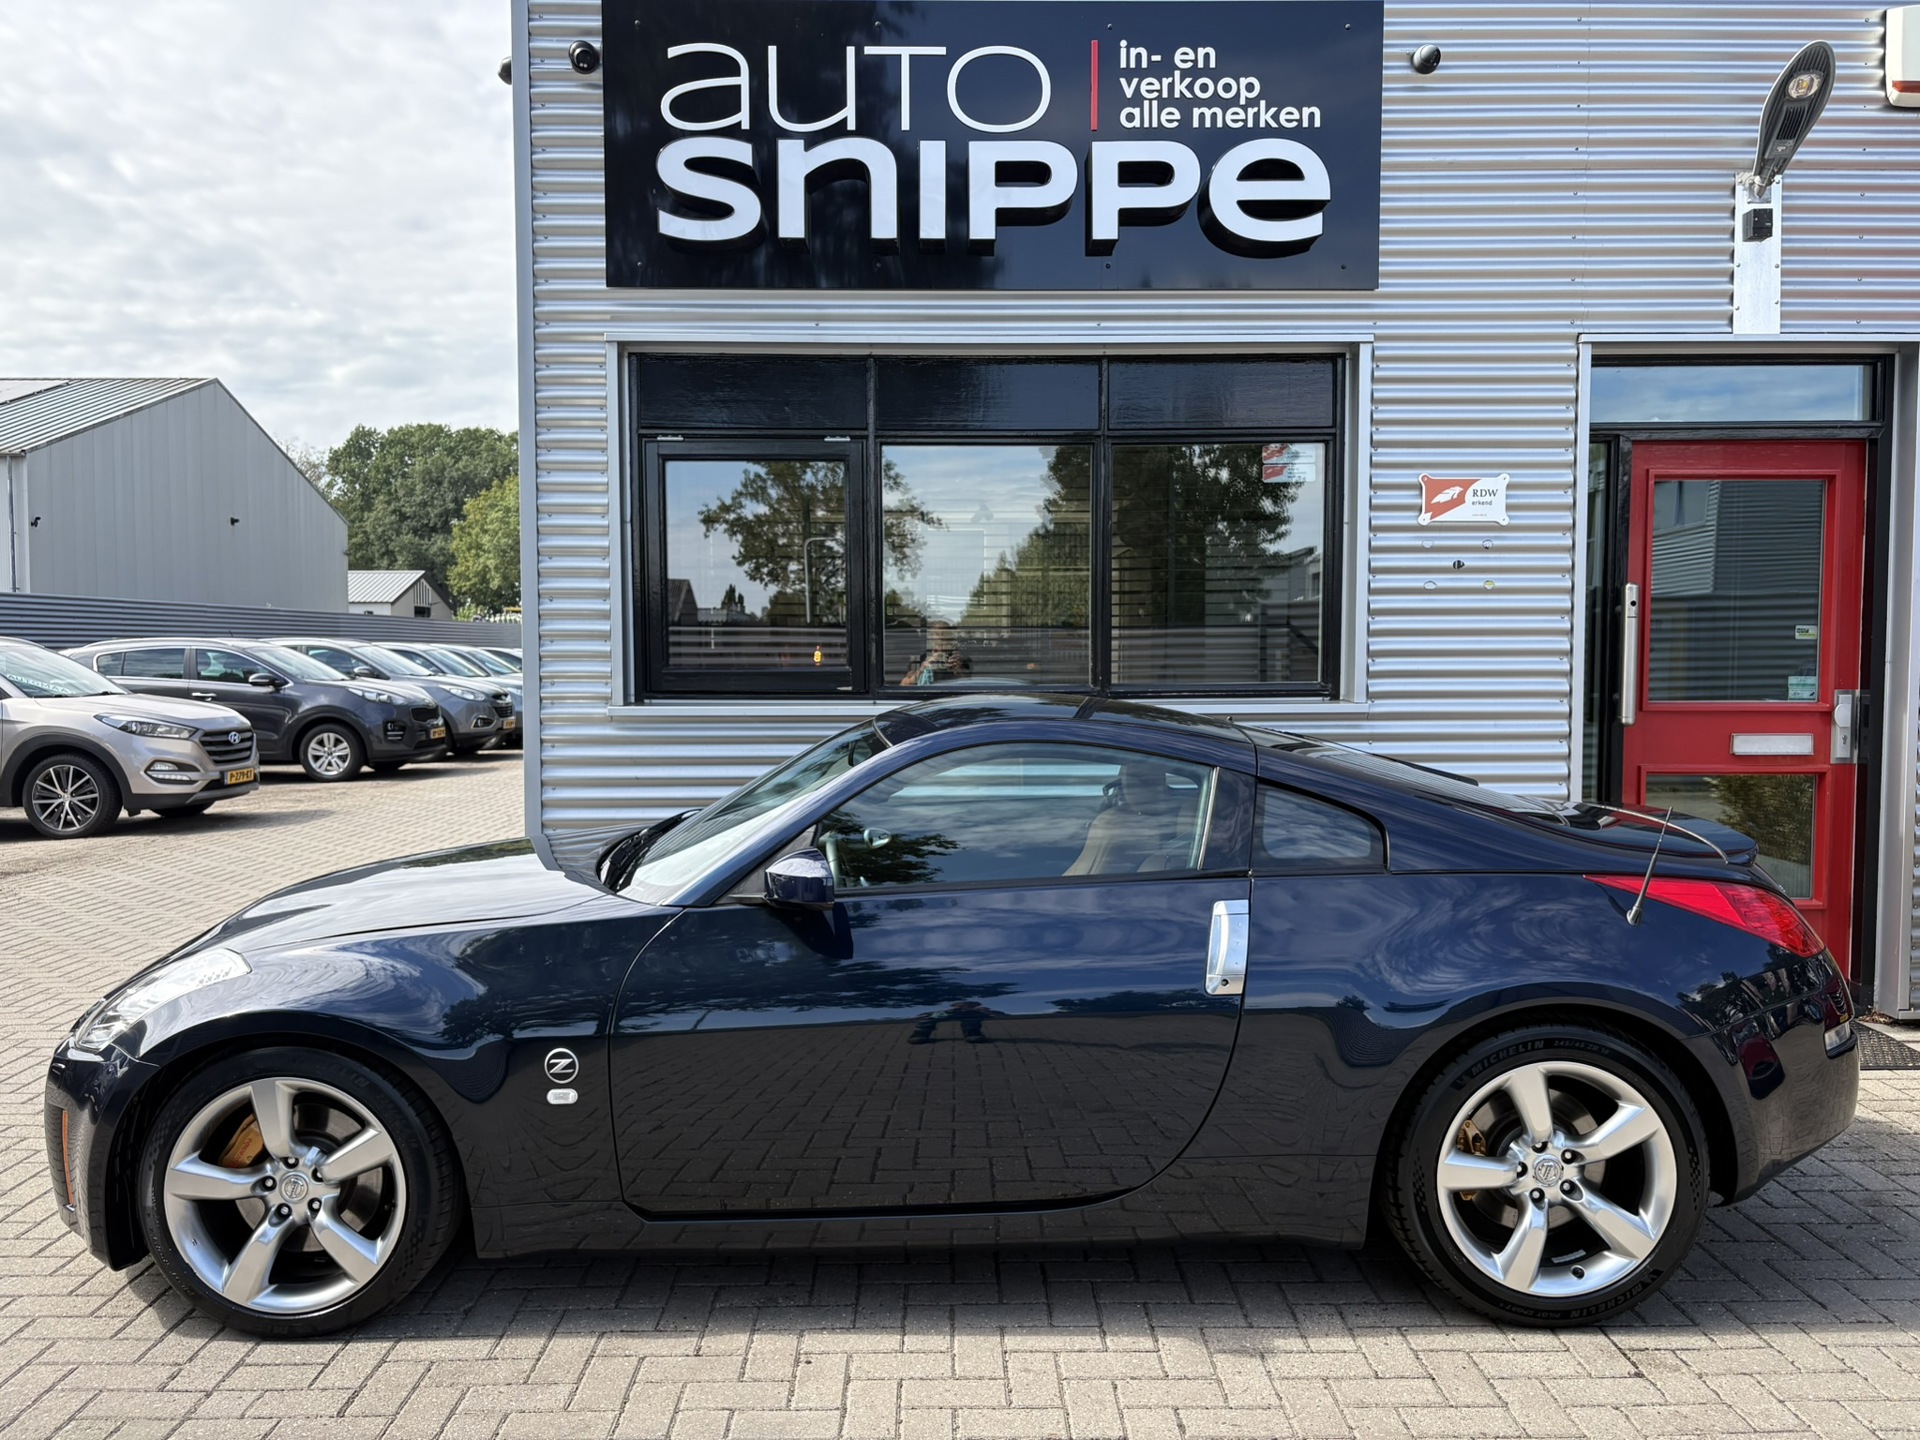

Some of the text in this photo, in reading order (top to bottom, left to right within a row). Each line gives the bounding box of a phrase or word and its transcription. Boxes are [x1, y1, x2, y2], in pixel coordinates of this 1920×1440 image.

[1119, 39, 1216, 69] in- en
[1119, 70, 1261, 105] verkoop
[1119, 100, 1322, 129] alle merken
[1472, 488, 1499, 498] RDW
[1470, 1039, 1545, 1075] MICHELIN
[1569, 1282, 1643, 1319] MICHELIN
